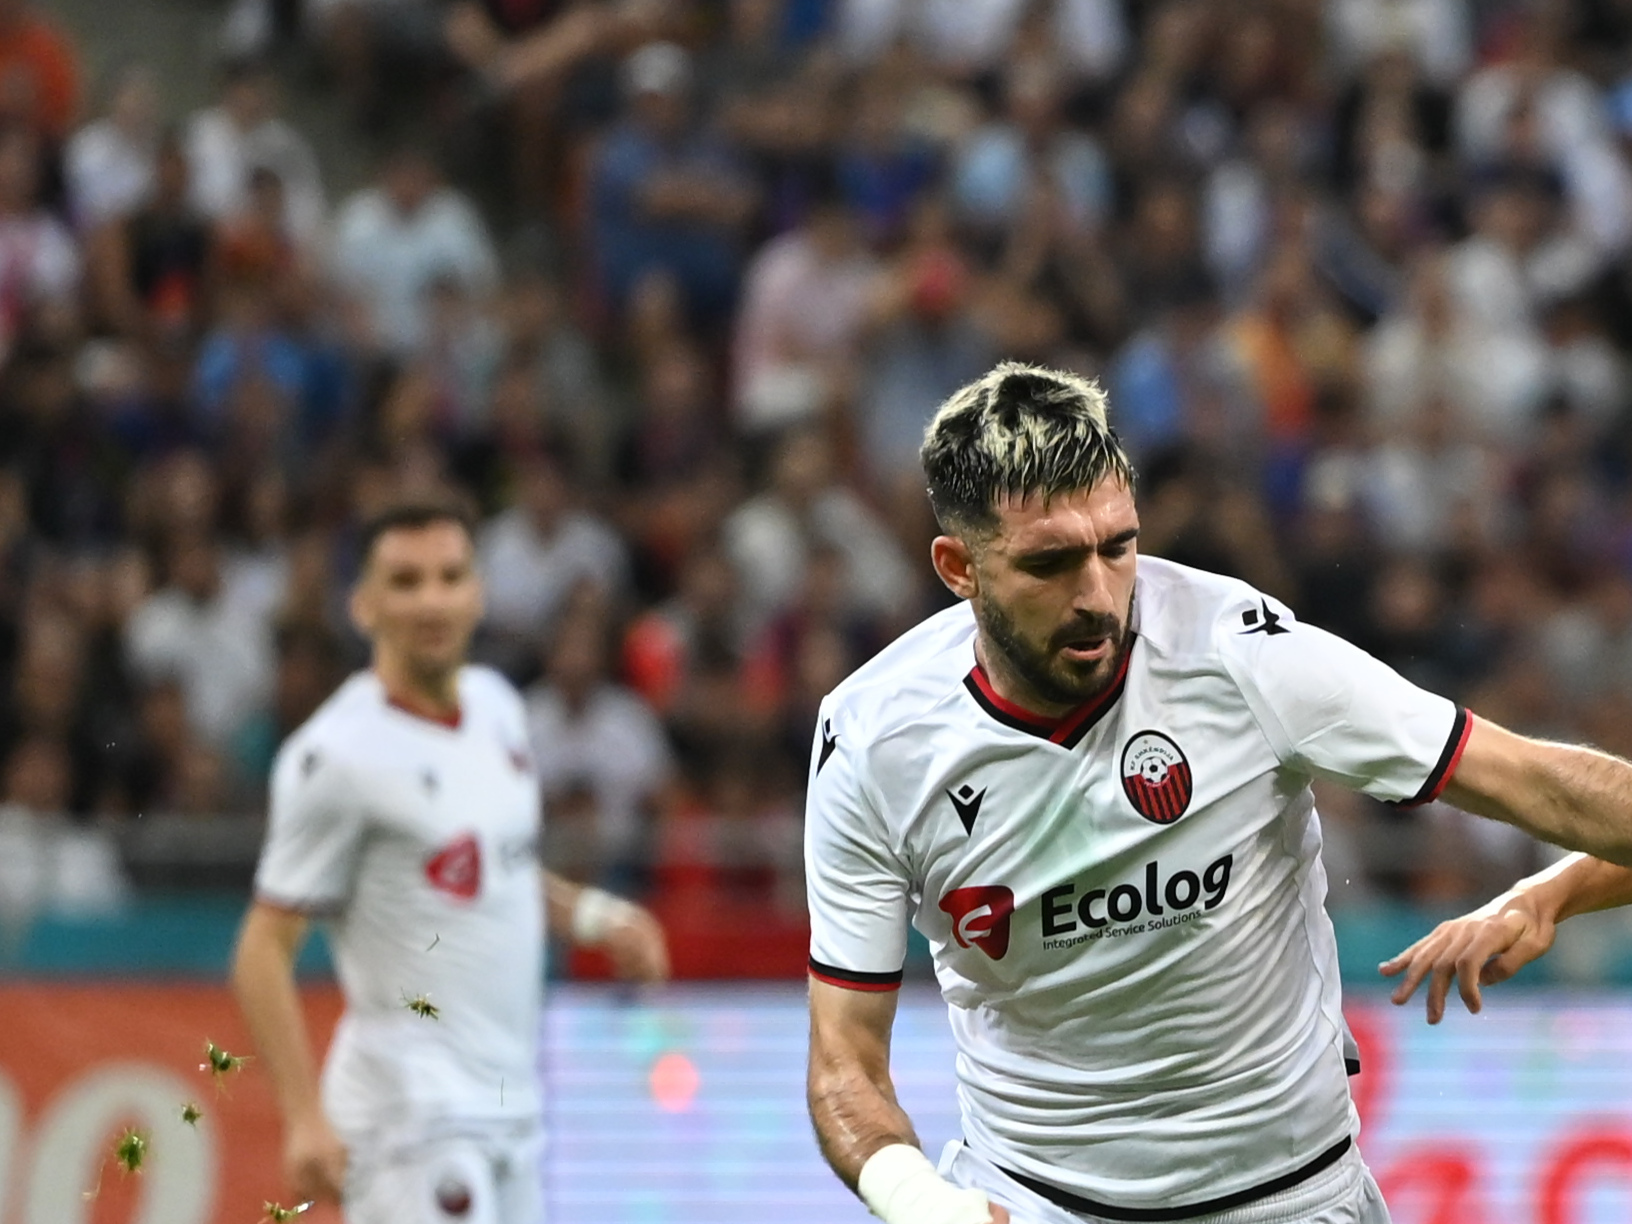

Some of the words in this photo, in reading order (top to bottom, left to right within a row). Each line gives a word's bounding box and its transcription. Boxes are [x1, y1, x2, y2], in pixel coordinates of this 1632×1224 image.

[1041, 853, 1233, 937] Ecolog
[1043, 929, 1104, 950] Integrated
[1105, 922, 1146, 938] Service
[1148, 909, 1202, 932] Solutions
